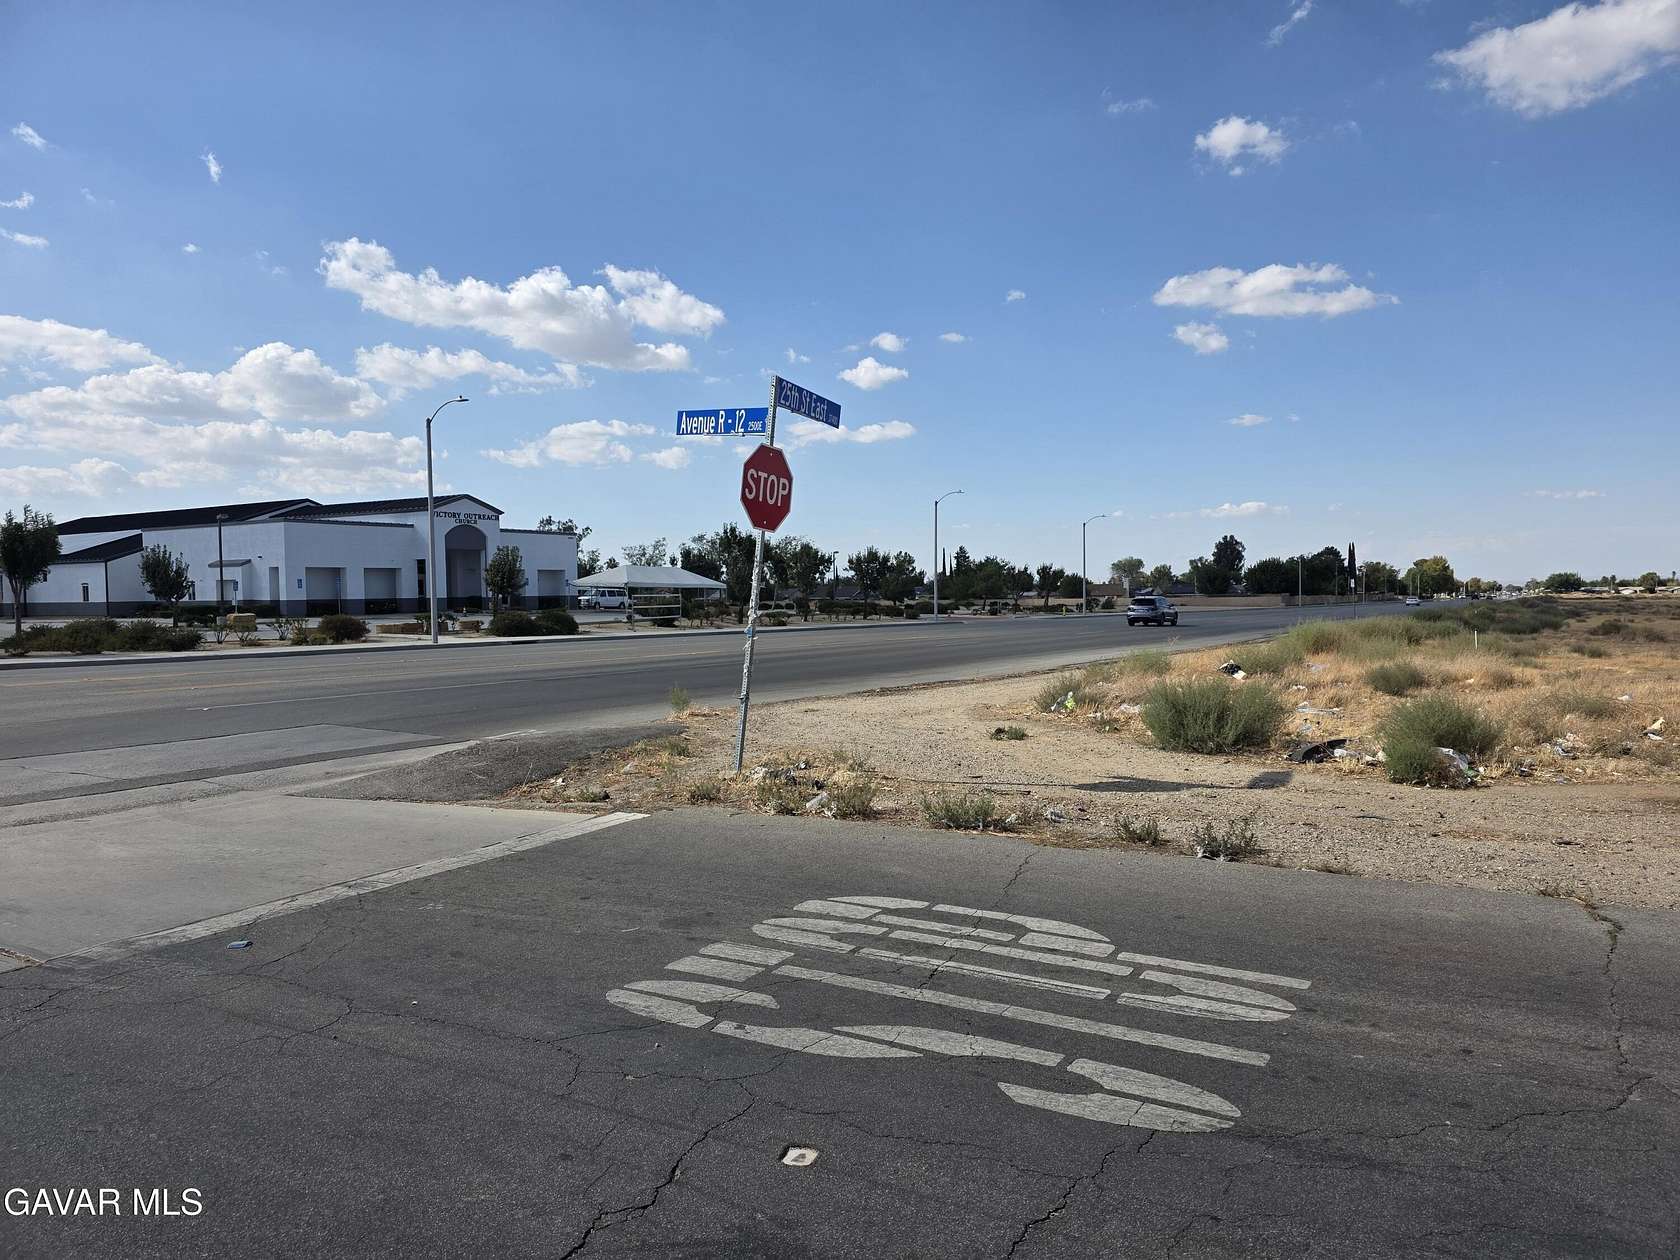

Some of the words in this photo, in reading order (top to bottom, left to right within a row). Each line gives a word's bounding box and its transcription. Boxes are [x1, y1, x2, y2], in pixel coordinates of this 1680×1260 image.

[780, 381, 799, 409] 25th
[801, 390, 810, 414] St
[811, 395, 828, 422] East
[680, 411, 715, 434] Avenue
[718, 410, 725, 433] R
[735, 409, 746, 433] 12
[745, 468, 790, 507] STOP
